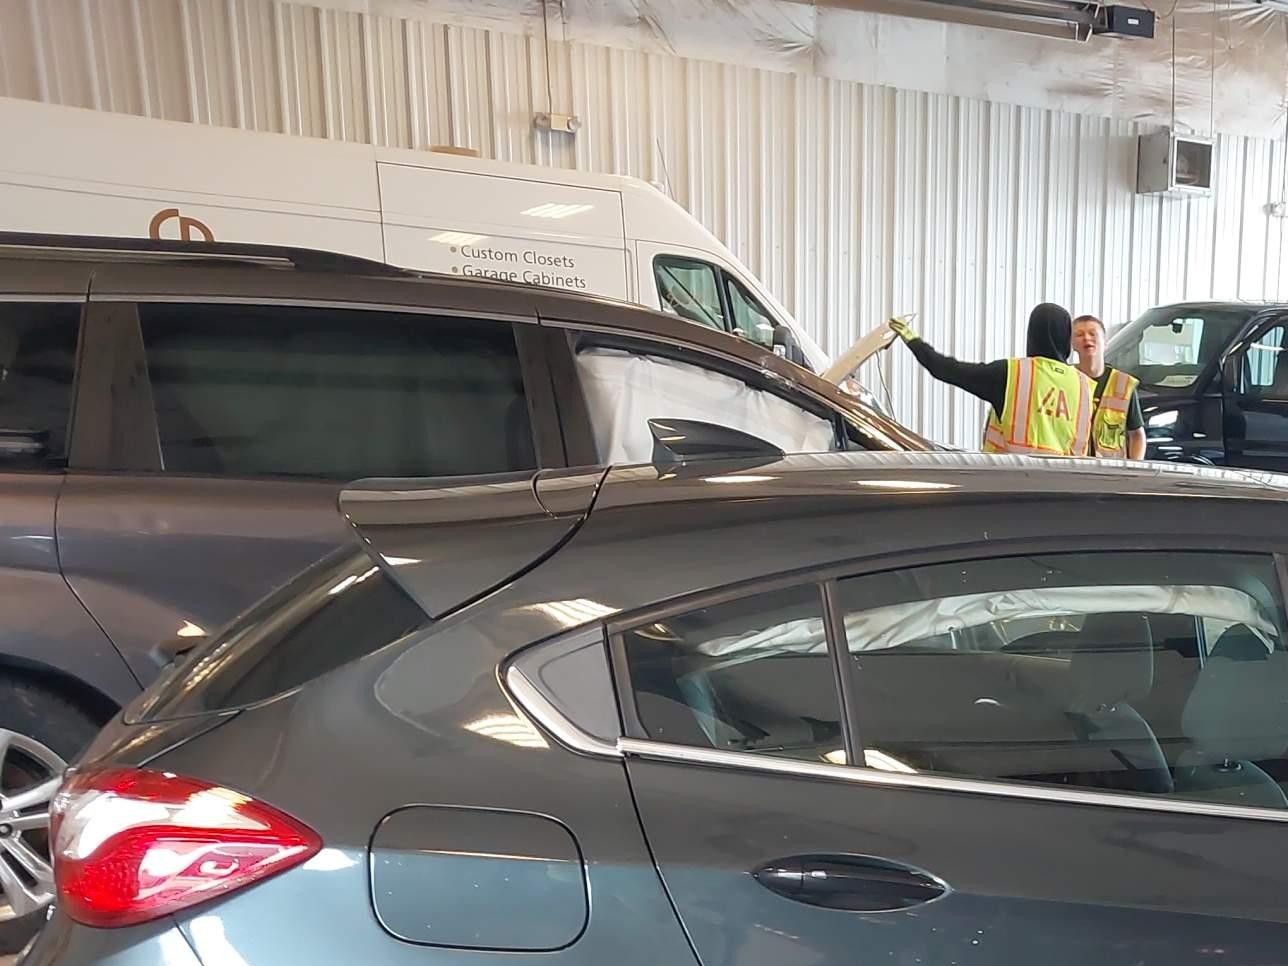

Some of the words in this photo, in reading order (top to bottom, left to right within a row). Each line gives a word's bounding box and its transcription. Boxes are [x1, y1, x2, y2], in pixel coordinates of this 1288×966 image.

[460, 244, 518, 263] Custom
[523, 250, 575, 268] Closets
[522, 270, 586, 289] Cabinets
